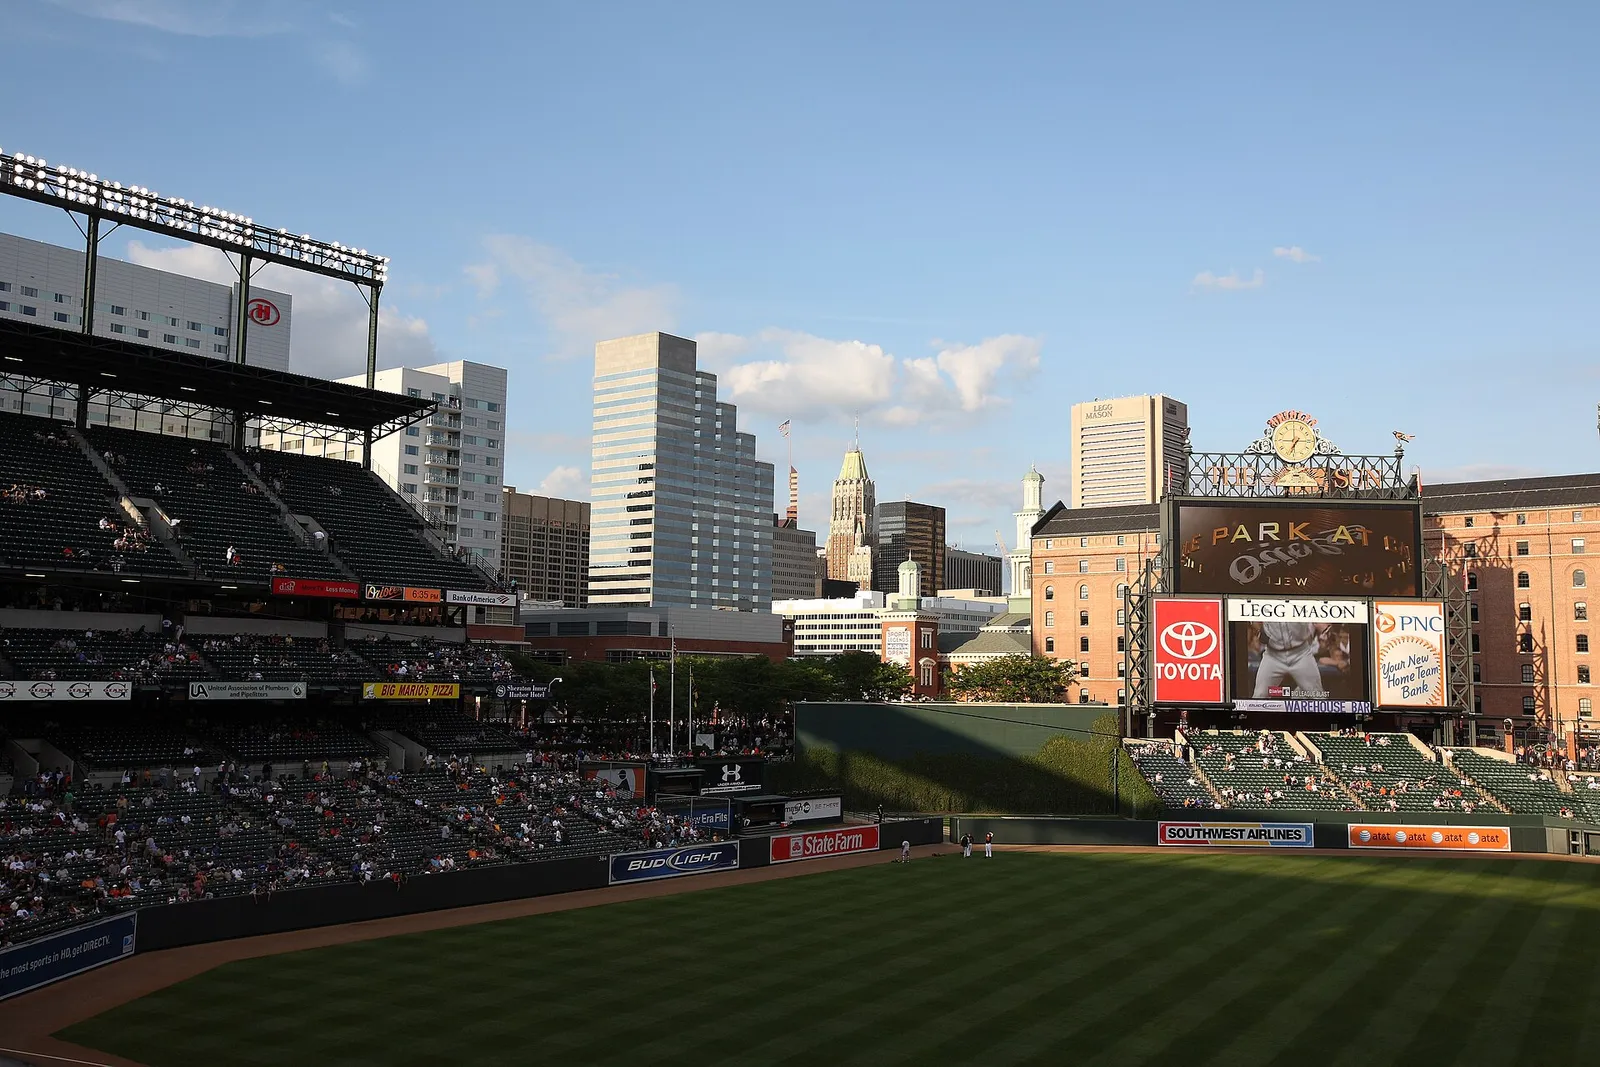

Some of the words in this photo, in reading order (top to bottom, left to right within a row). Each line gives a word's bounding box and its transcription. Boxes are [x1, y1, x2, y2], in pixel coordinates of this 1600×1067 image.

[1085, 411, 1113, 419] MASON
[1093, 404, 1113, 412] LEGG
[1334, 469, 1383, 488] SUN
[1212, 521, 1312, 546] PARK
[1332, 525, 1373, 547] AT
[412, 590, 429, 599] 6:35
[452, 594, 466, 602] Bank
[473, 595, 496, 604] America
[1240, 603, 1286, 618] LEGG
[1292, 605, 1356, 619] MASON
[1399, 615, 1442, 632] PNC
[1156, 662, 1222, 681] TOYOTA
[1382, 660, 1406, 679] Your
[1407, 654, 1429, 668] New
[1387, 672, 1415, 689] Home
[1415, 665, 1439, 680] Team
[191, 683, 208, 698] UA
[208, 683, 227, 691] United
[228, 683, 258, 691] Association
[265, 683, 289, 691] Plumbers
[381, 684, 396, 696] BIG
[398, 684, 430, 696] MARIO's
[432, 684, 454, 696] PIZZA
[1401, 680, 1429, 699] Bank
[1284, 700, 1346, 712] WAREHOUSE
[1352, 701, 1370, 713] BAR
[701, 813, 714, 823] Era
[714, 812, 728, 823] Fits
[1168, 827, 1245, 840] SOUTHWEST
[1247, 828, 1302, 840] AIRLINES
[1372, 832, 1390, 841] at&t
[1408, 833, 1426, 842] at&t
[1444, 834, 1463, 842] at&t
[1481, 835, 1499, 843] at&t
[805, 835, 834, 855] State
[834, 832, 863, 851] Farm
[627, 858, 666, 871] BUD
[673, 851, 722, 866] LIGHT
[11, 961, 29, 975] most
[29, 954, 52, 970] sports
[52, 951, 59, 962] in
[60, 947, 71, 960] HD,
[72, 945, 83, 958] get
